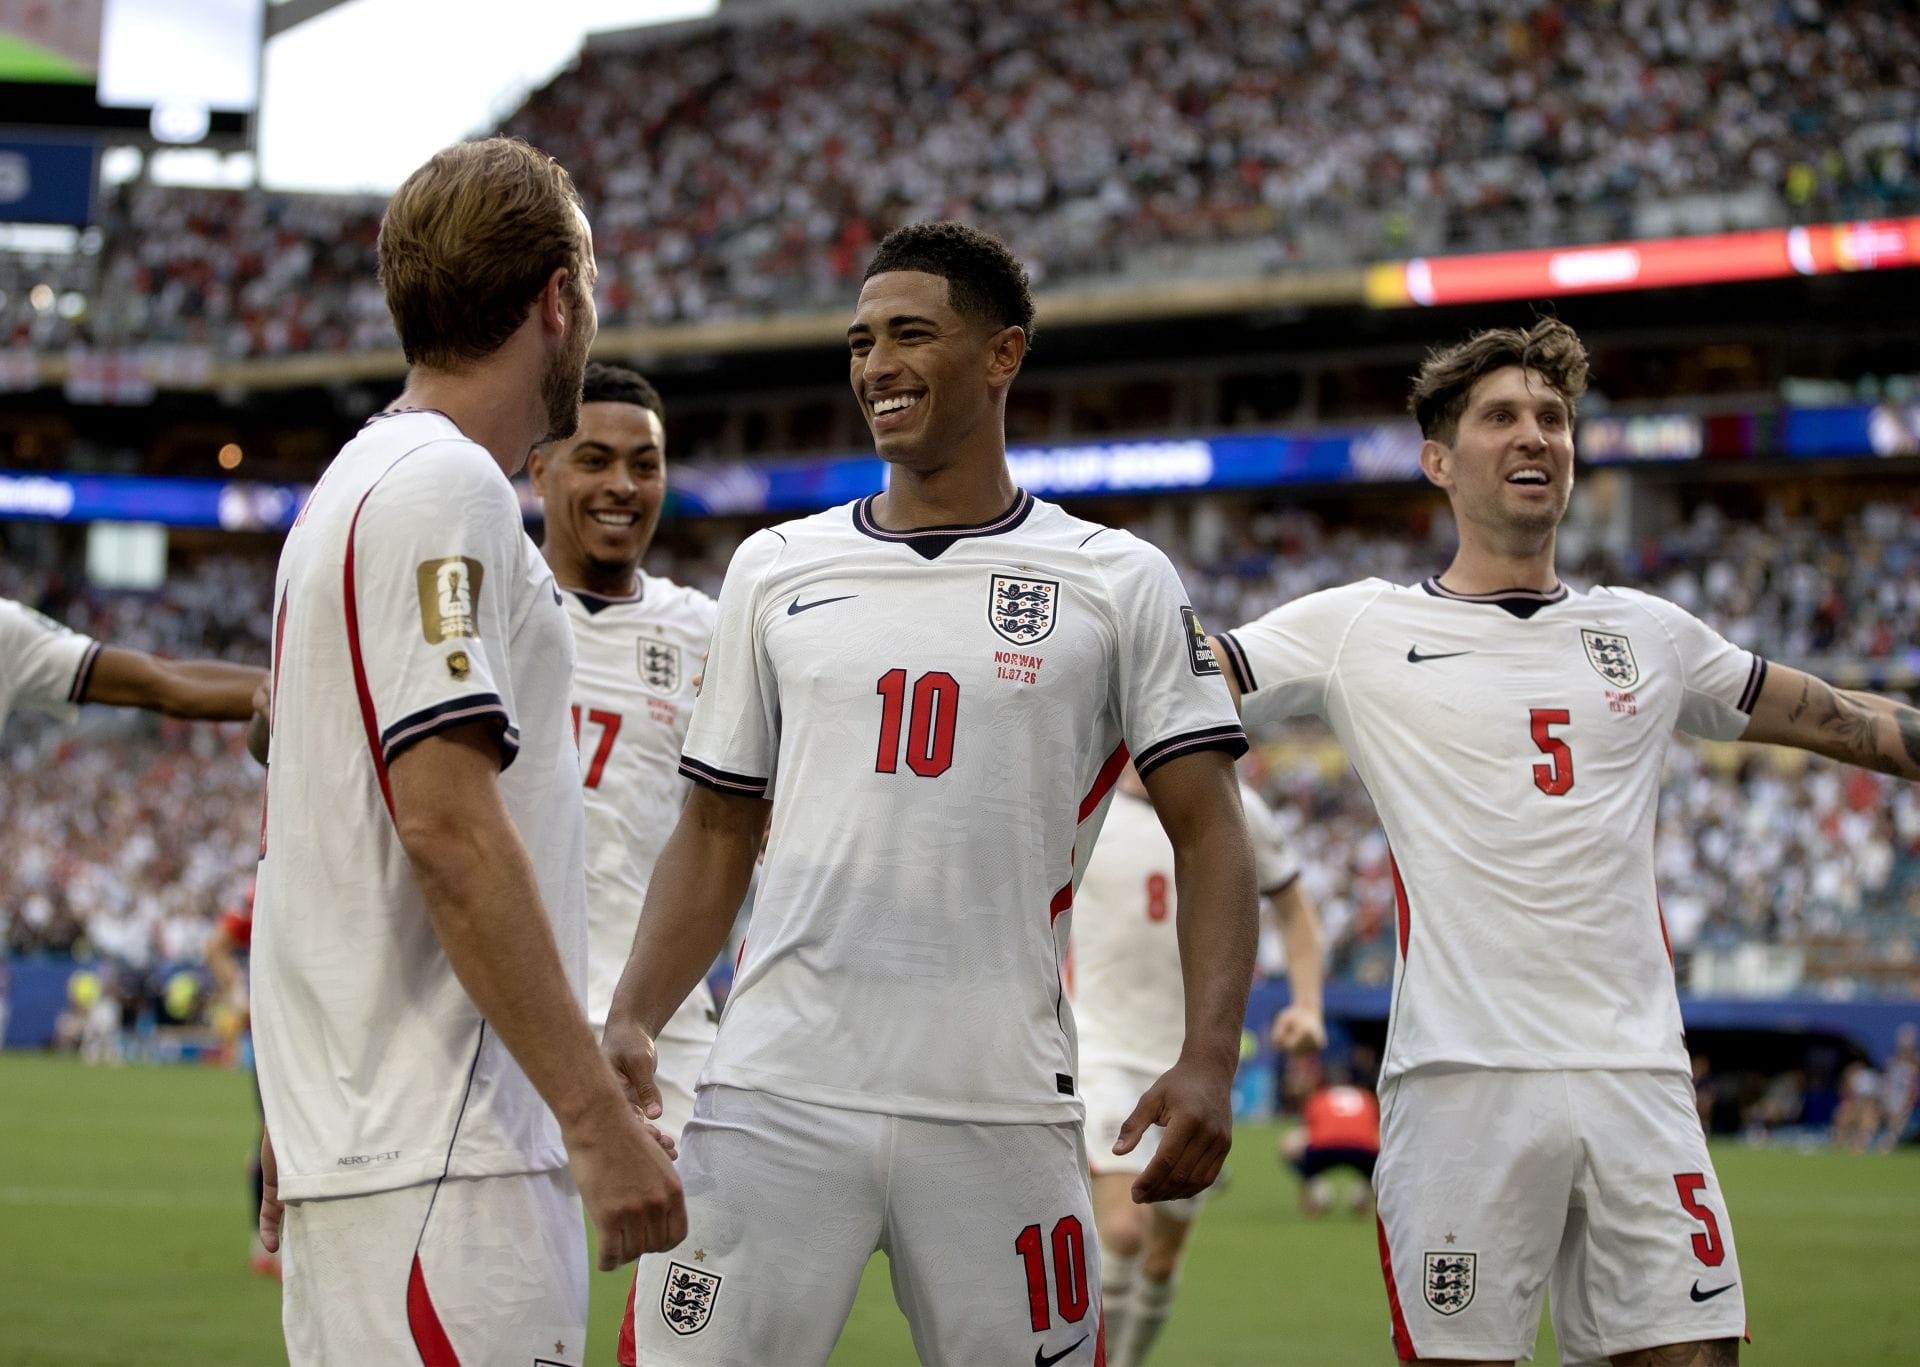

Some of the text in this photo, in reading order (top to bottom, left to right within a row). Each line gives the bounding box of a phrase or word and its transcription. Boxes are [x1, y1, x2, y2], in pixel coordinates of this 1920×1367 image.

[994, 651, 1043, 669] NORWAY
[997, 666, 1036, 684] 11.07.26
[875, 668, 960, 777] 10
[1529, 709, 1574, 796] 5
[1146, 873, 1168, 922] 8
[337, 1150, 402, 1166] AERO-FIT
[1673, 1173, 1725, 1267] 5
[1015, 1214, 1089, 1332] 10
